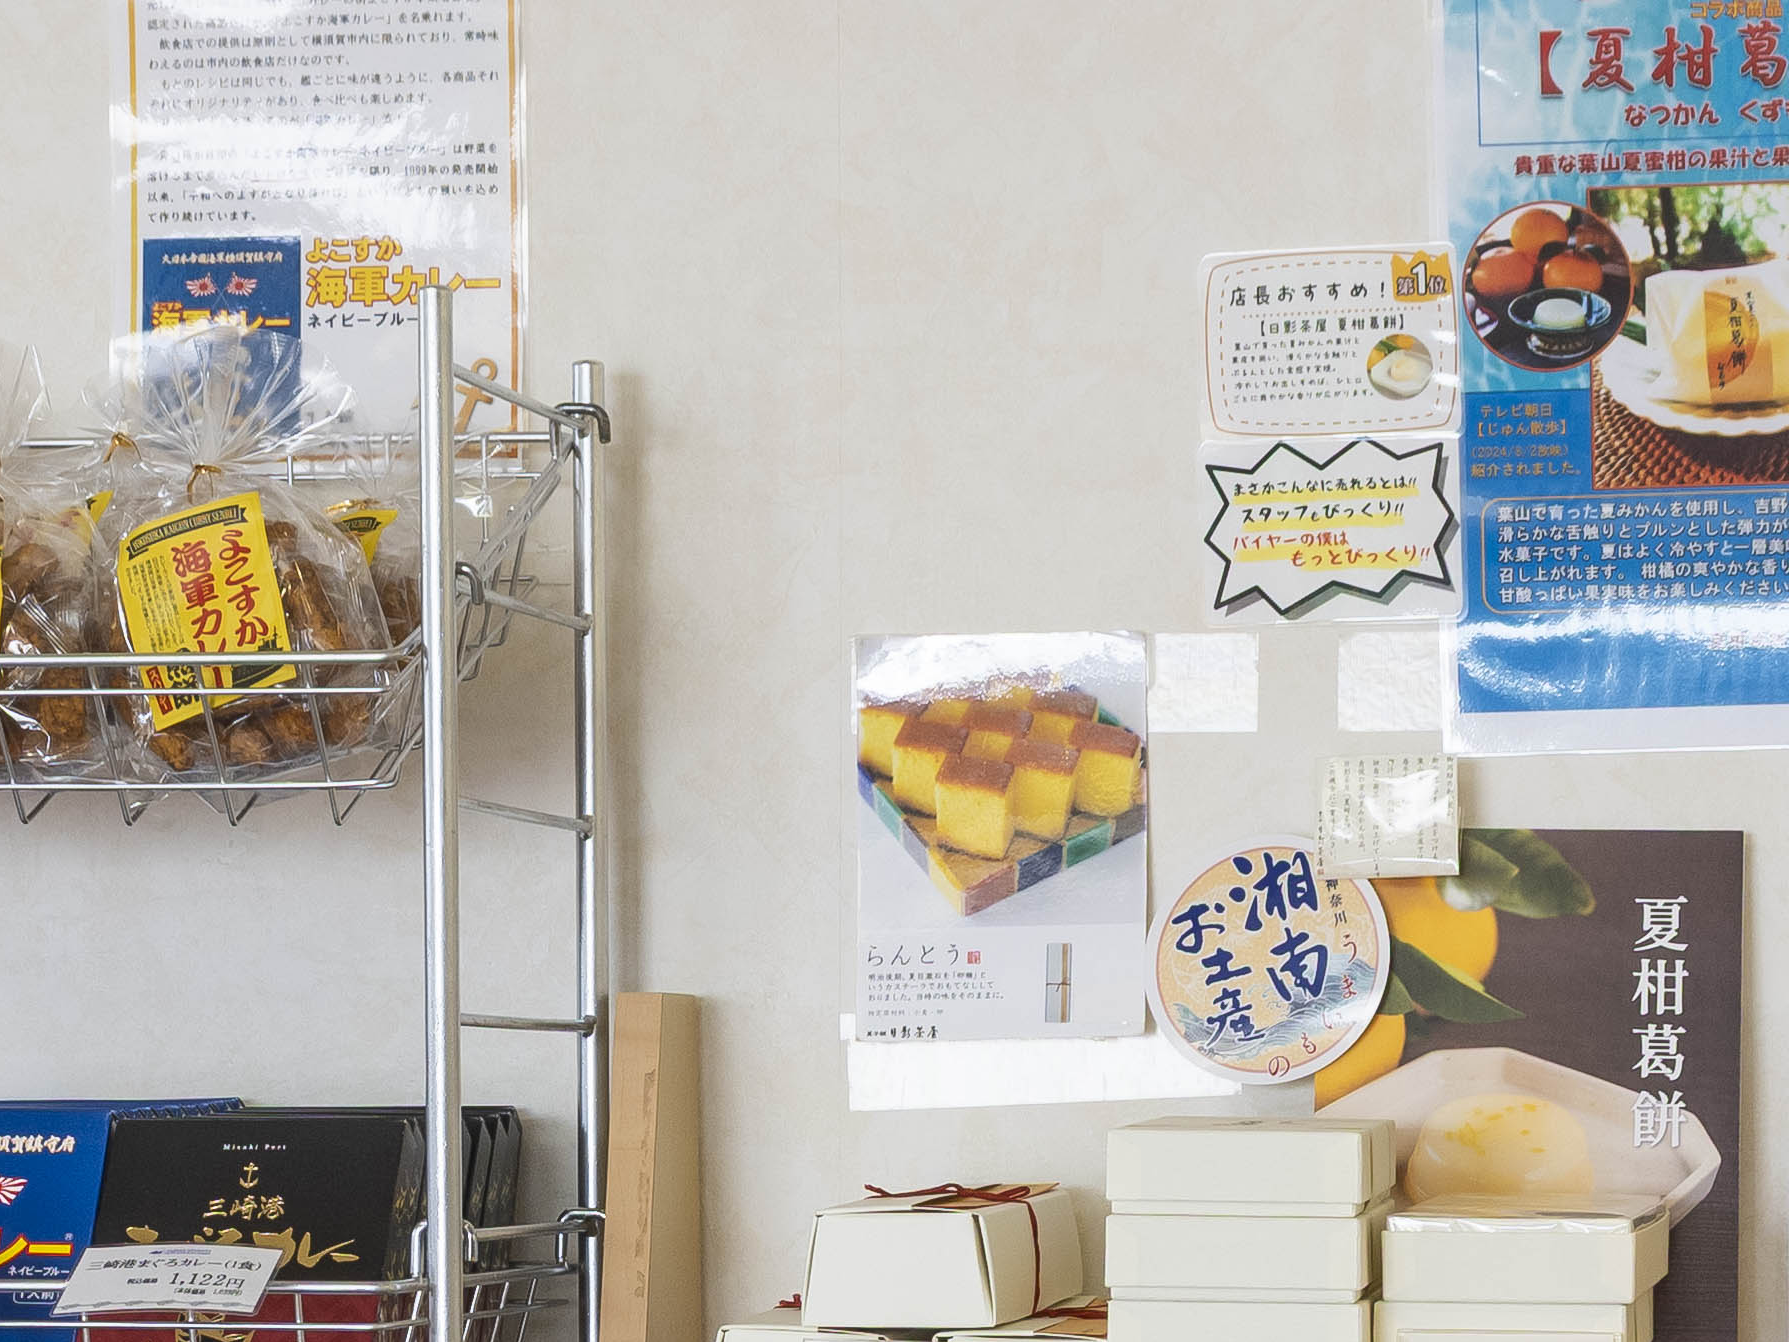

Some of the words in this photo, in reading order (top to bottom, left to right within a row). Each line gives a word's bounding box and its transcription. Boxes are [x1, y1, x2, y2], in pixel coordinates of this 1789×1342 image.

[1624, 101, 1719, 126] なつかん
[306, 237, 403, 263] よこすか
[1480, 402, 1553, 418] テレビ朝日
[1471, 461, 1581, 478] 紹介されました。
[1233, 531, 1348, 550] バイヤーの僕は
[1499, 564, 1625, 584] 召し上がれます。
[220, 529, 269, 646] よこすか
[1229, 851, 1330, 1001] 湘南
[867, 943, 960, 967] らんとう
[1171, 902, 1266, 1047] お土産
[1631, 895, 1690, 1149] 夏柑葛餅
[203, 1195, 285, 1220] 三崎港
[7, 1265, 70, 1277] ネイビーブルー
